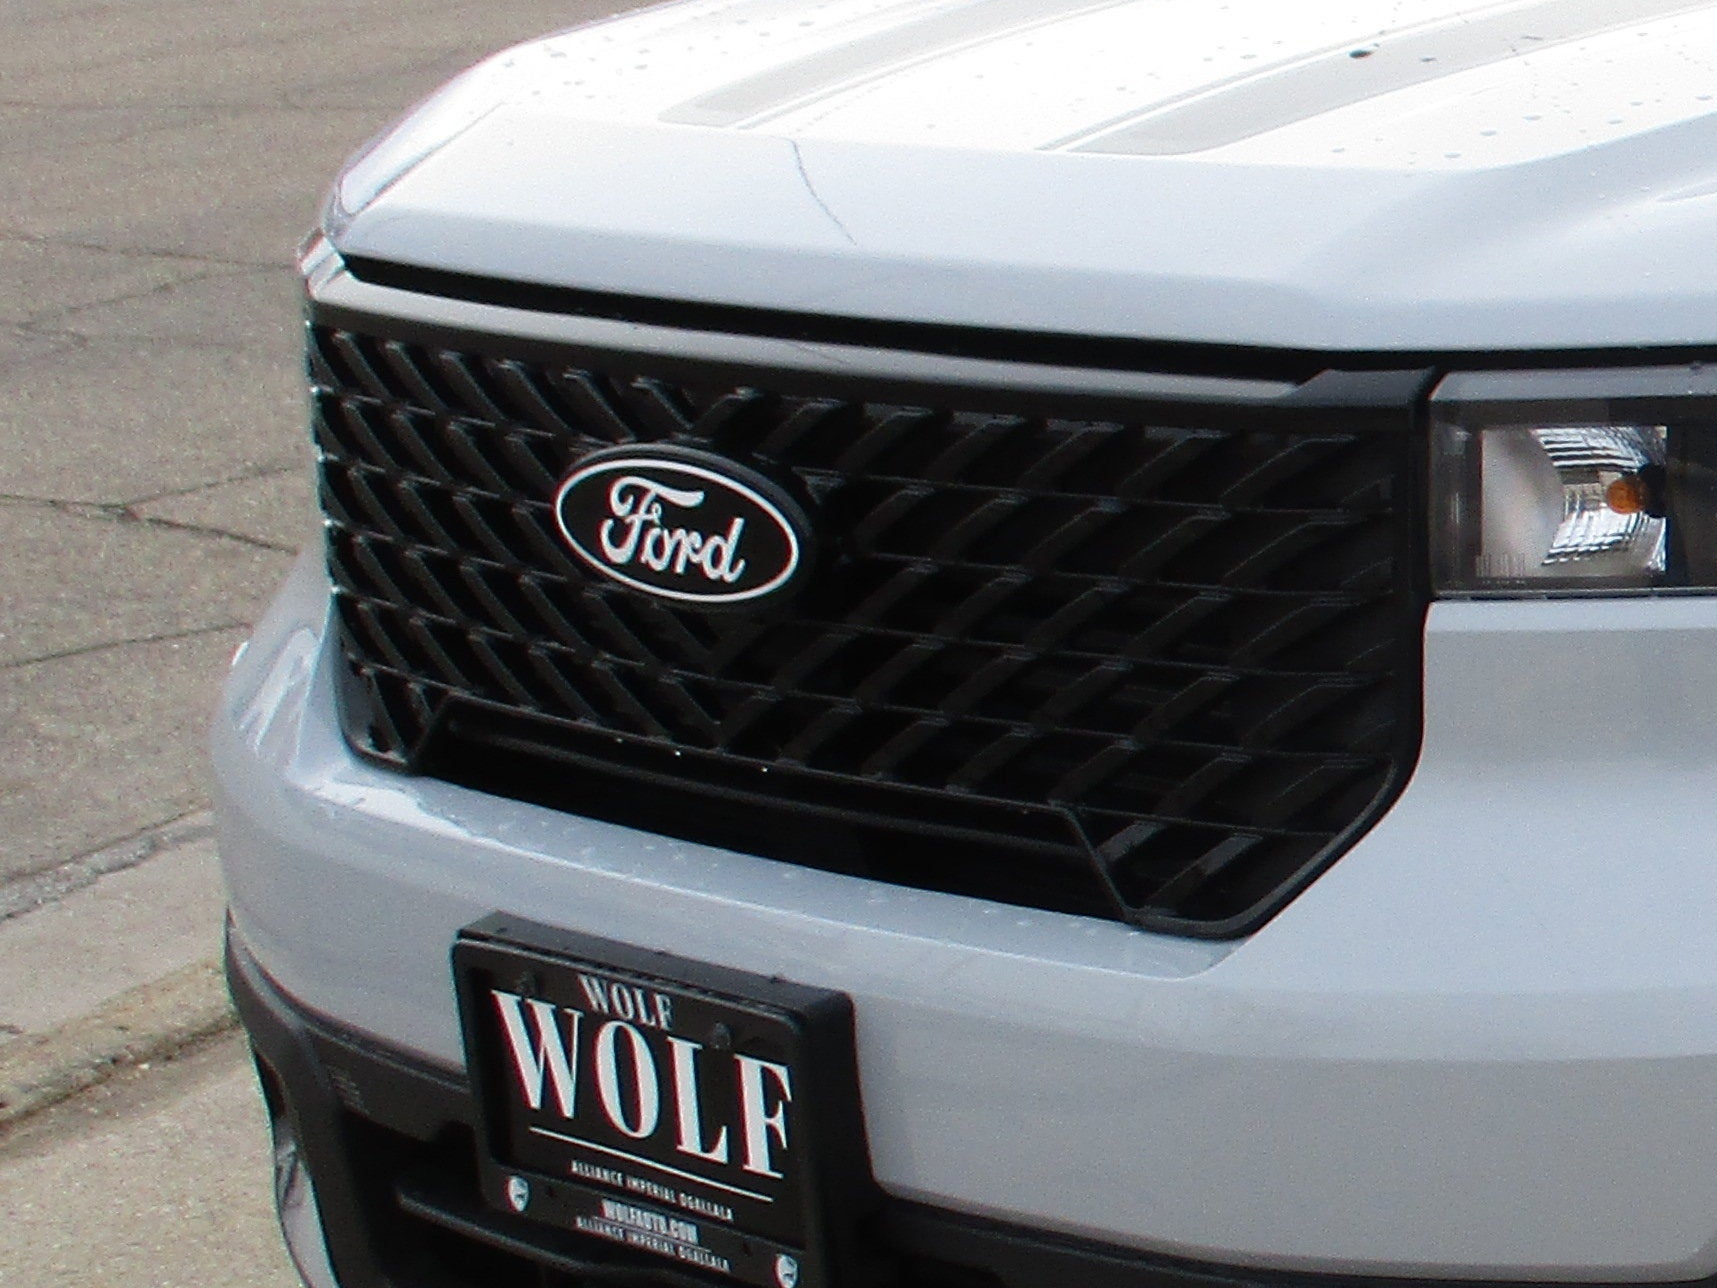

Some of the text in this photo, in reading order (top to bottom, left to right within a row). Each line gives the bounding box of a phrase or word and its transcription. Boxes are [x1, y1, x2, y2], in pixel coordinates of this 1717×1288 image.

[599, 475, 746, 584] Ford
[577, 973, 671, 1030] WOLF
[490, 988, 793, 1179] WOLF
